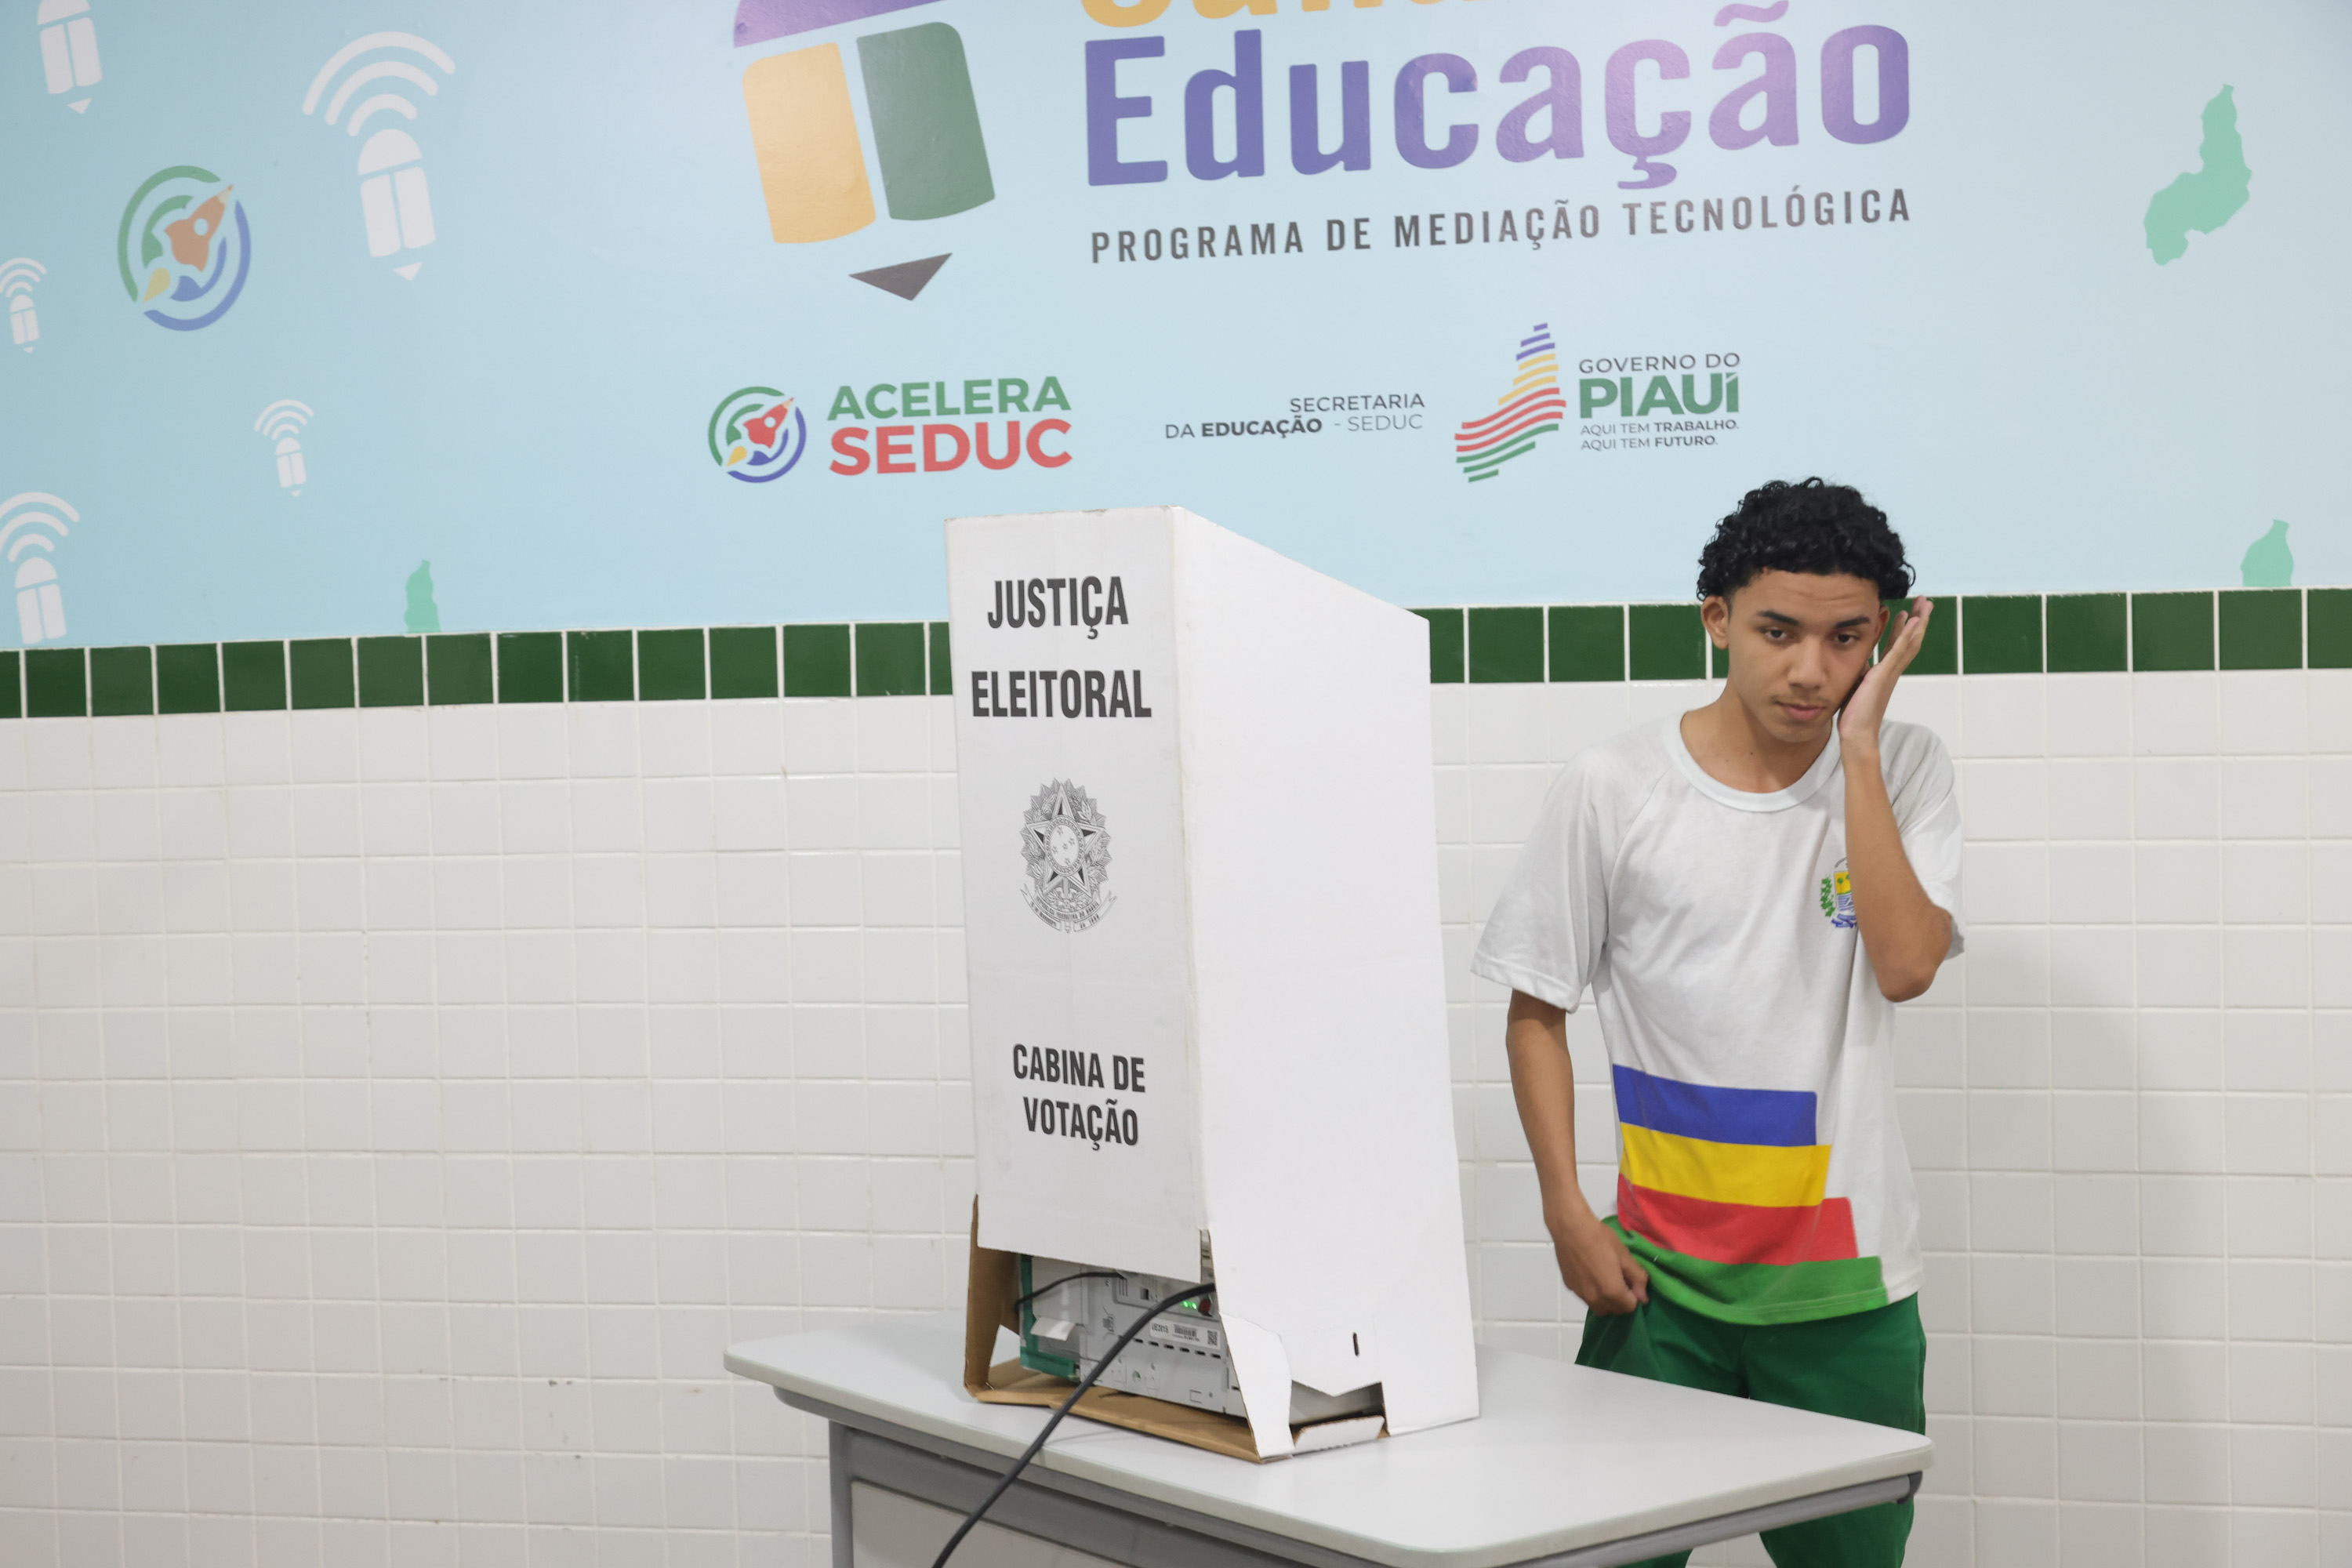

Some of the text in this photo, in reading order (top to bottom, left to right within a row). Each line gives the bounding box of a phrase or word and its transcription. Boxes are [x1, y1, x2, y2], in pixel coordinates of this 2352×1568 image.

[1084, 0, 1910, 190] Educação
[1091, 185, 1910, 264] PROGRAMA DE MEDIAÇÃO TECNOLÓGICA
[1579, 352, 1740, 374] GOVERNO DO
[827, 376, 1072, 421] ACELERA
[1290, 393, 1425, 412] SECRETARIA
[1579, 372, 1739, 419] PIAUÍ
[829, 418, 1073, 476] SEDUC
[1165, 423, 1196, 438] DA
[1200, 415, 1323, 438] EDUCAÇÃO
[1348, 414, 1423, 432] SEDUC
[1581, 425, 1617, 437] AQUI
[1620, 423, 1650, 434] TEM
[1581, 439, 1617, 451] AQUI
[1621, 438, 1650, 448] TEM
[987, 575, 1129, 640] JUSTIÇA
[971, 670, 1152, 719] ELEITORAL
[1013, 1044, 1145, 1093] CABINA DE
[1022, 1096, 1138, 1151] VOTAÇÃO
